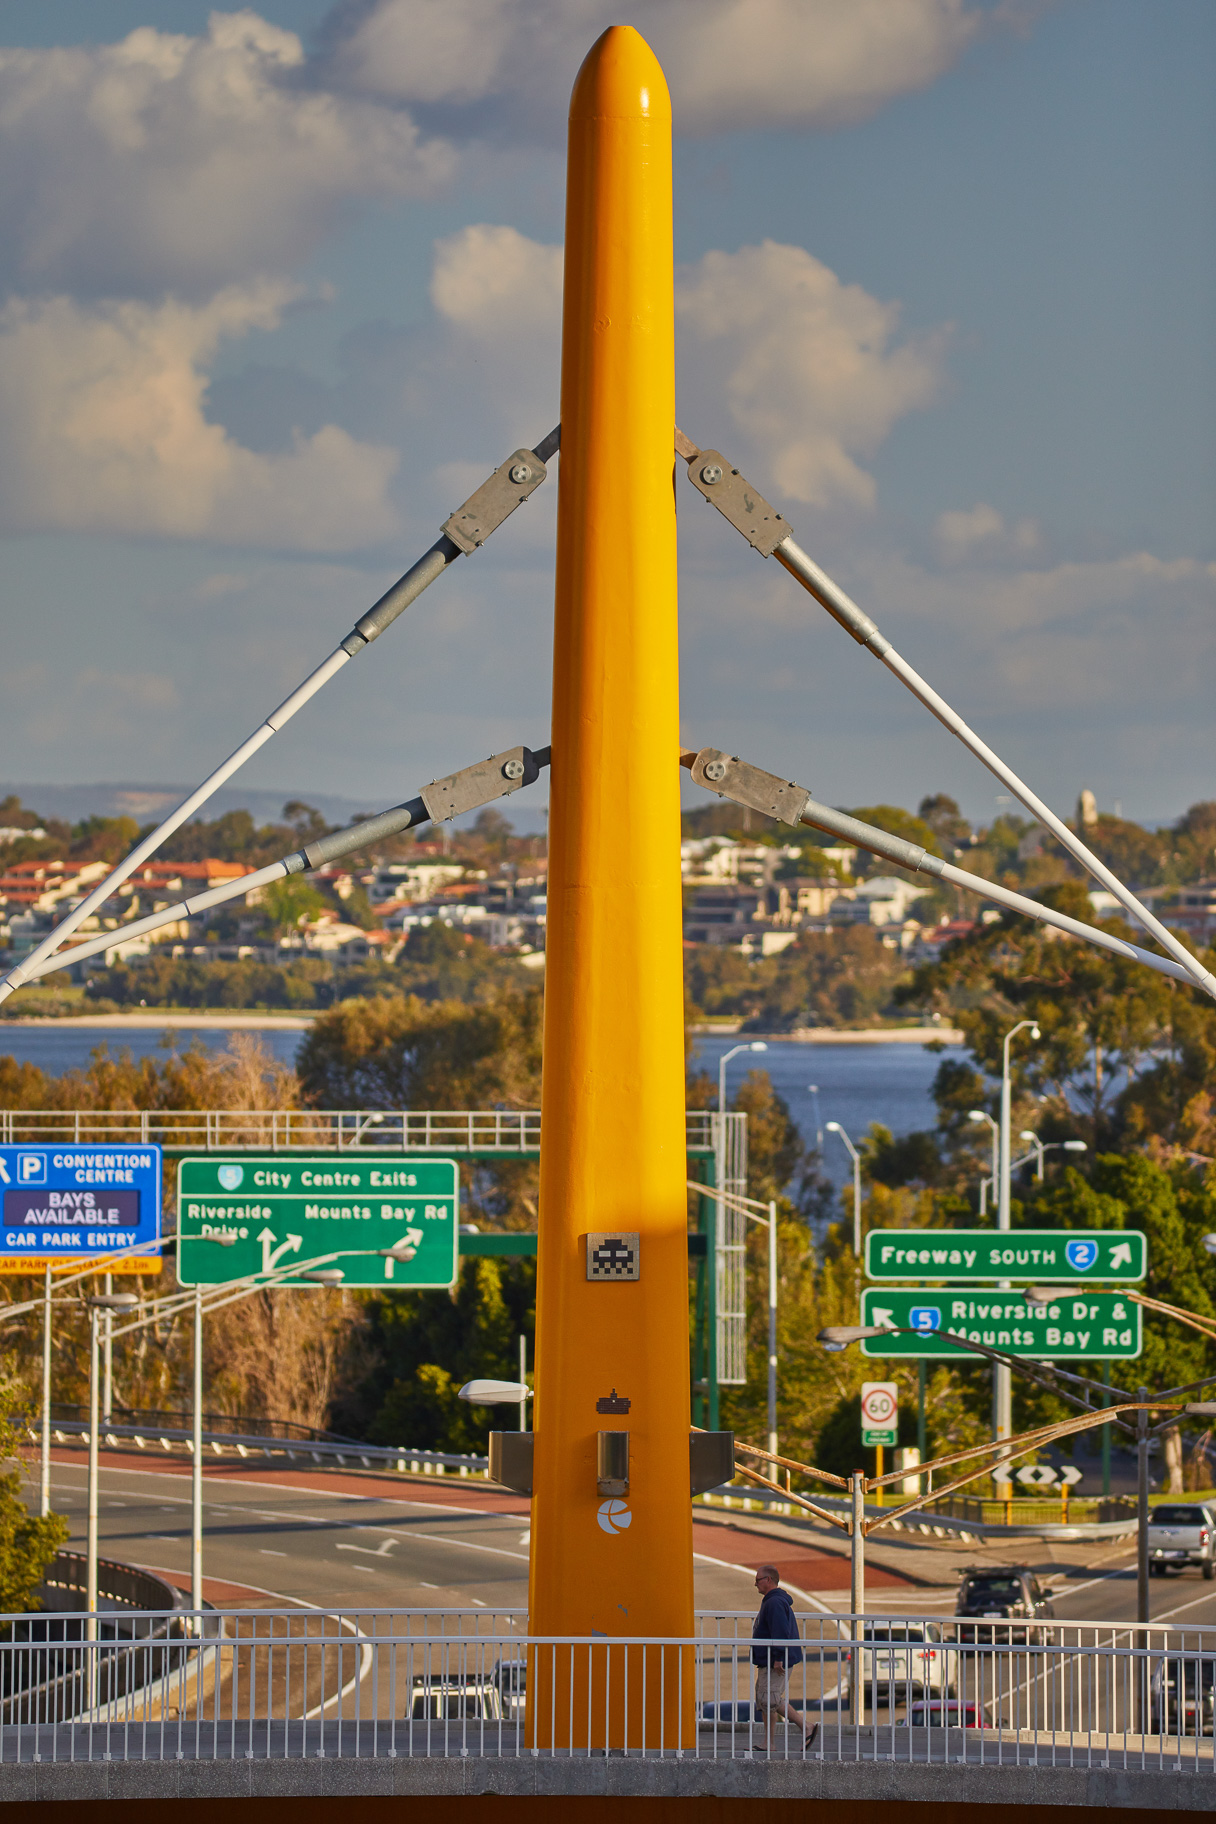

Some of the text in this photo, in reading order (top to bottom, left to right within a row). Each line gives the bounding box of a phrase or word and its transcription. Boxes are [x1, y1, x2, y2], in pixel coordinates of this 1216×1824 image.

[23, 1156, 42, 1180] P
[53, 1154, 151, 1168] CONVENTION
[75, 1169, 134, 1183] CENTRE
[225, 1169, 417, 1189] 5 City Centre Exits
[48, 1192, 96, 1208] BAYS
[24, 1208, 120, 1225] AVAILABLE
[188, 1203, 272, 1219] Riverside
[304, 1204, 448, 1223] Mounts Bay Rd
[201, 1223, 249, 1239] Drive
[6, 1232, 136, 1247] CAR PARK ENTRY
[0, 1259, 17, 1269] AR
[881, 1244, 1090, 1268] Freeway SOUTH 2
[951, 1300, 1127, 1321] Riverside Dr &
[918, 1311, 933, 1330] 5
[947, 1326, 1132, 1350] Mounts Bay Rd
[869, 1398, 890, 1414] 60
